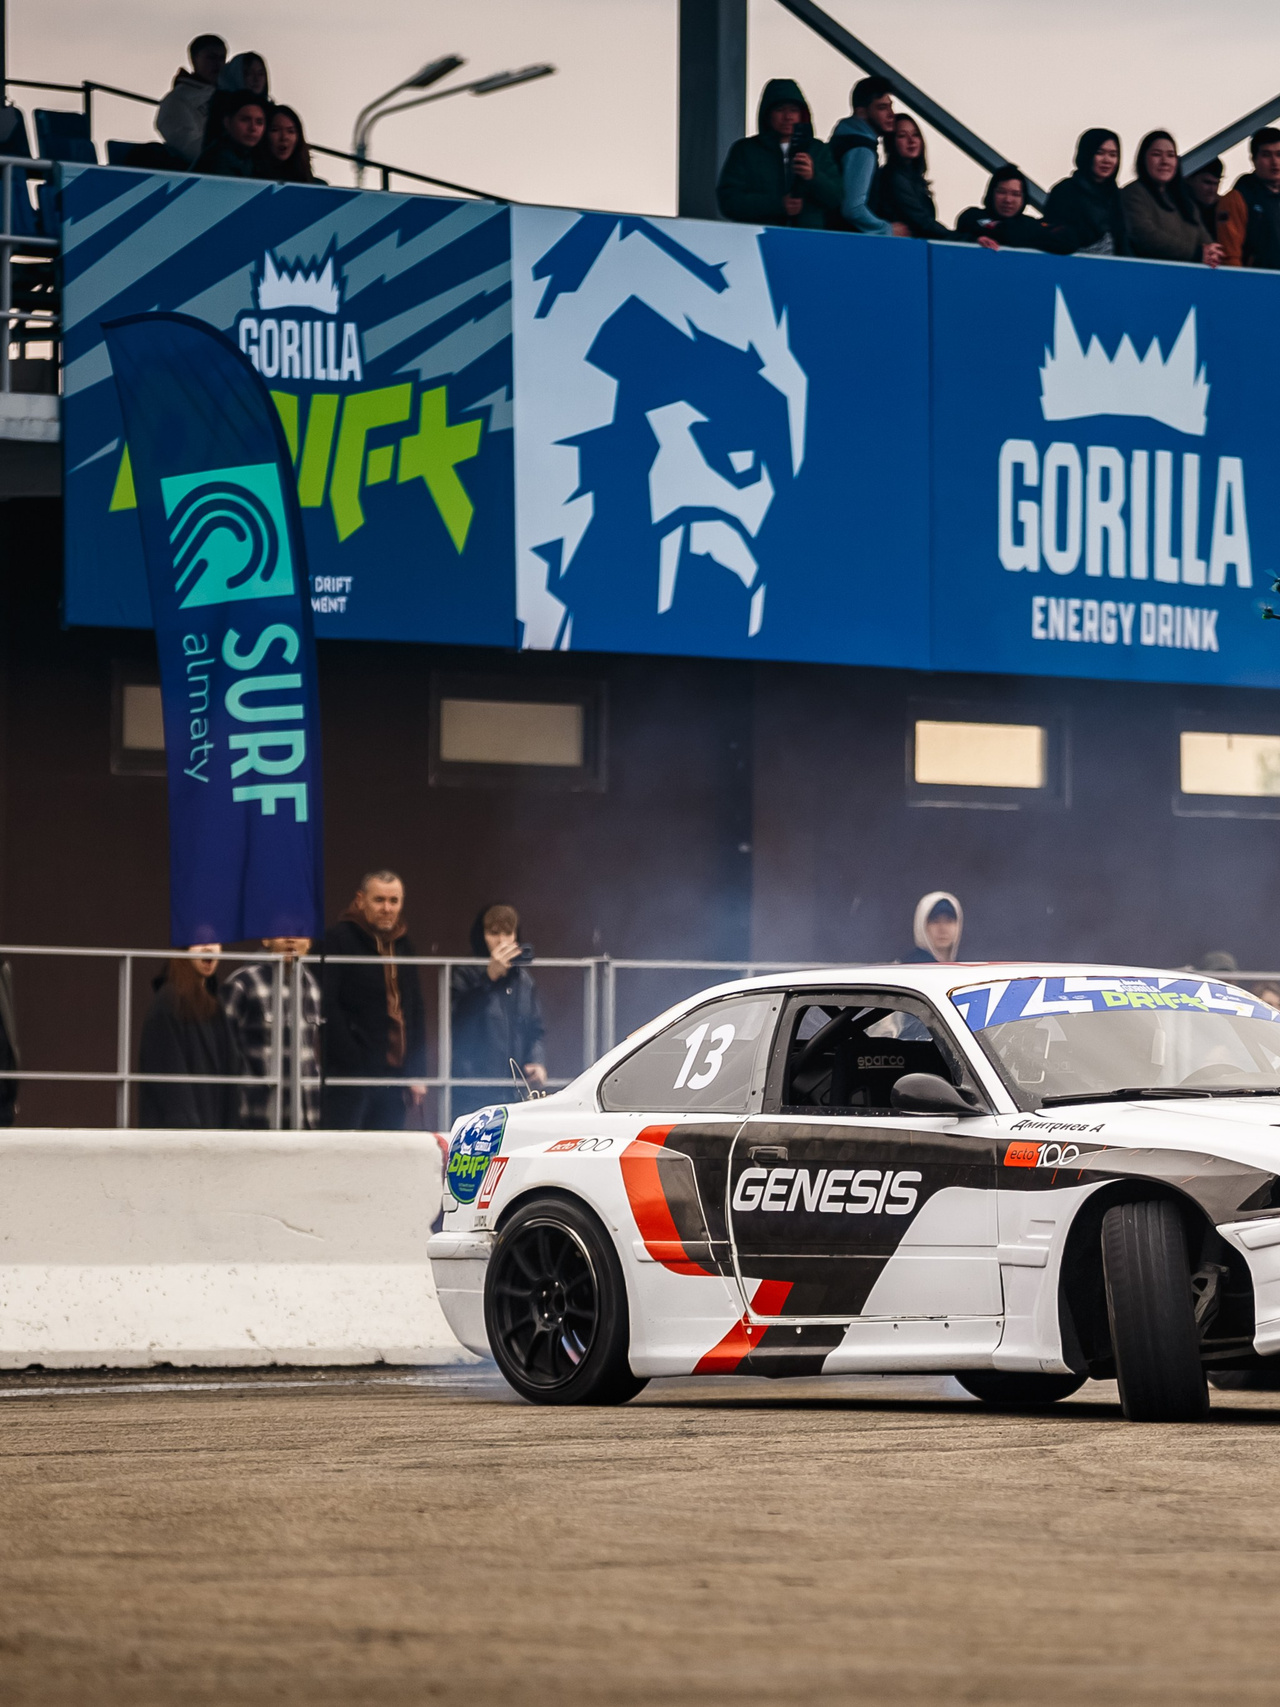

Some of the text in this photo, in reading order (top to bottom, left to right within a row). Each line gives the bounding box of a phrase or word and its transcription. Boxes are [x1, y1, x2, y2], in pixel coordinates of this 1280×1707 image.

[239, 317, 363, 382] GORILLA
[999, 438, 1254, 589] GORILLA
[314, 575, 353, 593] DRIFT
[1031, 595, 1220, 653] ENERGY DRINK
[182, 633, 215, 783] almaty
[222, 623, 309, 823] SURF
[1101, 991, 1210, 1012] DRIFT
[673, 1021, 735, 1090] 13
[857, 1055, 905, 1069] sparco
[1010, 1119, 1090, 1133] Дмитриев
[733, 1168, 923, 1215] GENESIS
